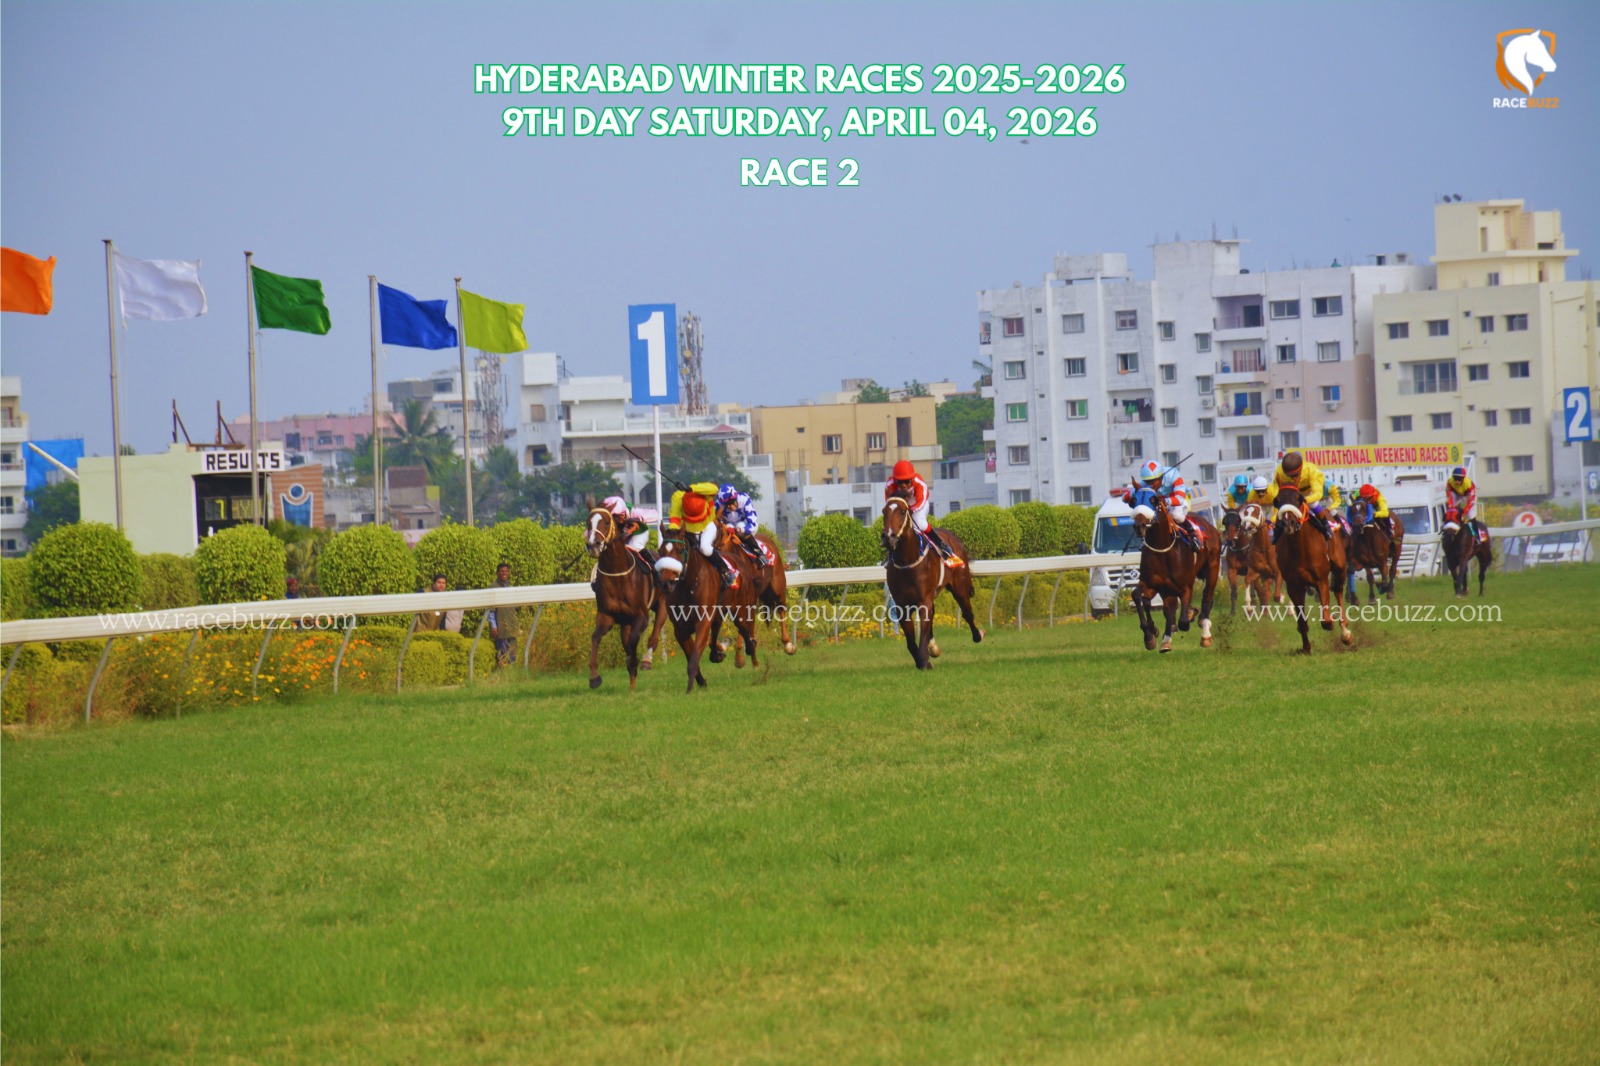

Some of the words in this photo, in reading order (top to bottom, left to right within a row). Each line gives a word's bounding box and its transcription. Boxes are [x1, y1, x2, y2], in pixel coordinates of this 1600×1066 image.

[637, 311, 667, 396] 1
[1566, 391, 1590, 438] 2
[206, 452, 280, 471] RESUTS
[1305, 448, 1372, 466] INVITATIONAL
[1374, 447, 1417, 463] WEEKEND
[1420, 446, 1449, 462] RACES
[1589, 472, 1597, 489] 6
